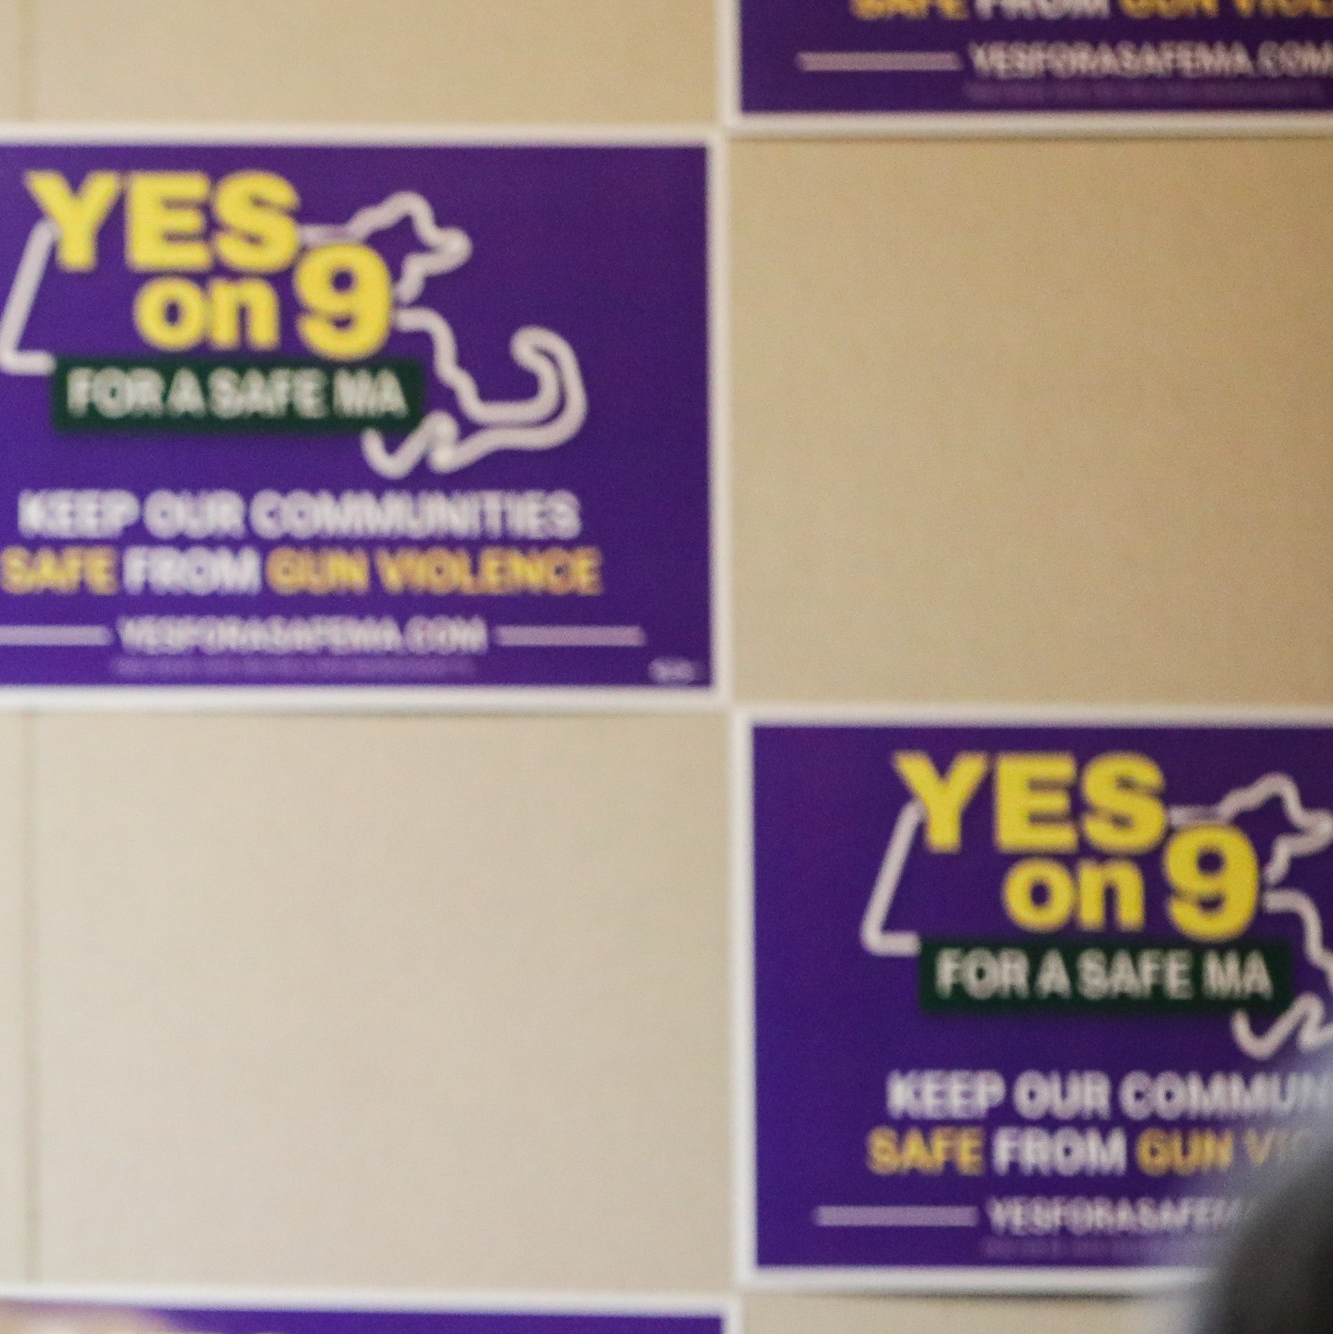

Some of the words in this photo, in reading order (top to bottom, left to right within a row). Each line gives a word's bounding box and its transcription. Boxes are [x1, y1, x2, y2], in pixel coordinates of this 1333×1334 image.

[25, 170, 299, 272] YES
[136, 276, 279, 350] on
[294, 243, 392, 360] 9
[67, 368, 165, 416] FOR
[167, 368, 205, 416] A
[208, 369, 326, 417] SAFE
[333, 370, 409, 416] MA
[18, 490, 139, 537] KEEP
[143, 490, 247, 537] OUR
[250, 491, 582, 537] COMMUNITIES
[0, 547, 118, 594] SAFE
[123, 548, 260, 594] FROM
[266, 549, 368, 594] GUN
[376, 549, 604, 595] VIOLENCE
[893, 749, 1167, 854] YES
[1003, 858, 1146, 933] on
[1163, 823, 1259, 941] 9
[936, 948, 1029, 999] FOR
[1035, 949, 1071, 998] A
[1079, 949, 1192, 999] SAFE
[1203, 948, 1273, 999] MA
[887, 1068, 1006, 1119] KEEP
[1013, 1069, 1111, 1120] OUR
[866, 1126, 984, 1175] SAFE
[992, 1127, 1127, 1176] FROM
[1137, 1128, 1233, 1174] GUN
